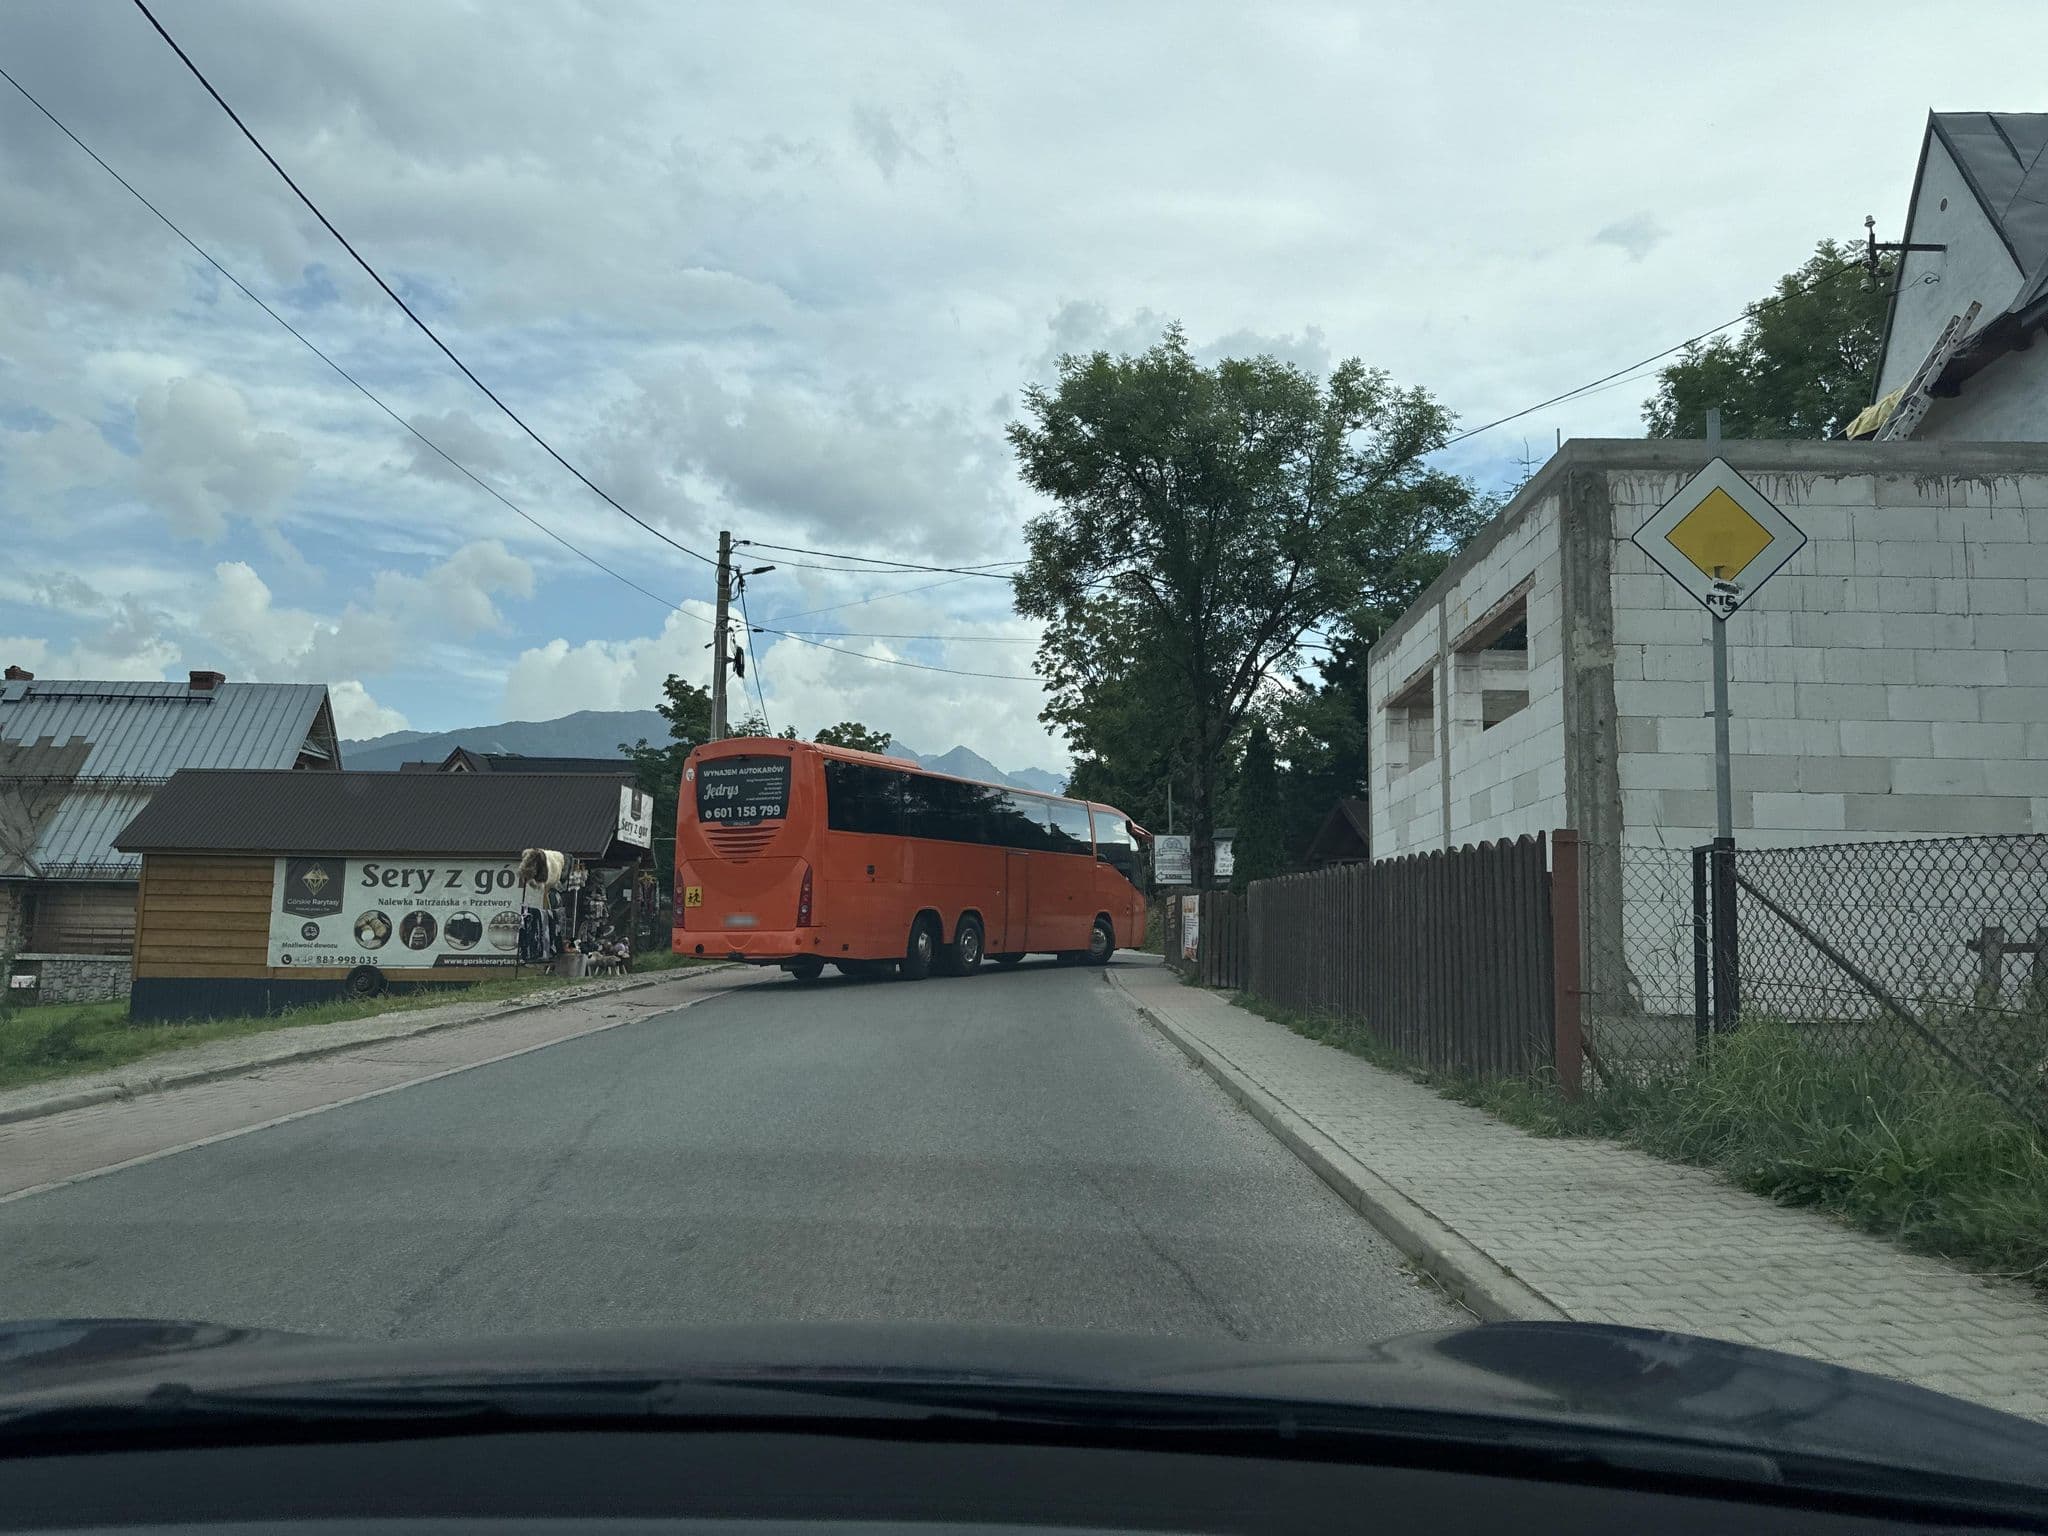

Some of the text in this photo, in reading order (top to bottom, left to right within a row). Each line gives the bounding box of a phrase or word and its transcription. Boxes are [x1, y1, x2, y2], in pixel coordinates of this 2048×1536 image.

[703, 764, 785, 777] WYNAJEM AUTOKARÓW
[713, 804, 781, 818] 601 158 799
[621, 818, 634, 835] Sery
[361, 863, 436, 894] Sery
[444, 868, 463, 887] z
[312, 898, 340, 907] Rarytasy
[377, 897, 512, 908] Nalewka Tatrzańska Przetwory
[337, 956, 356, 964] 998
[359, 956, 378, 965] 035
